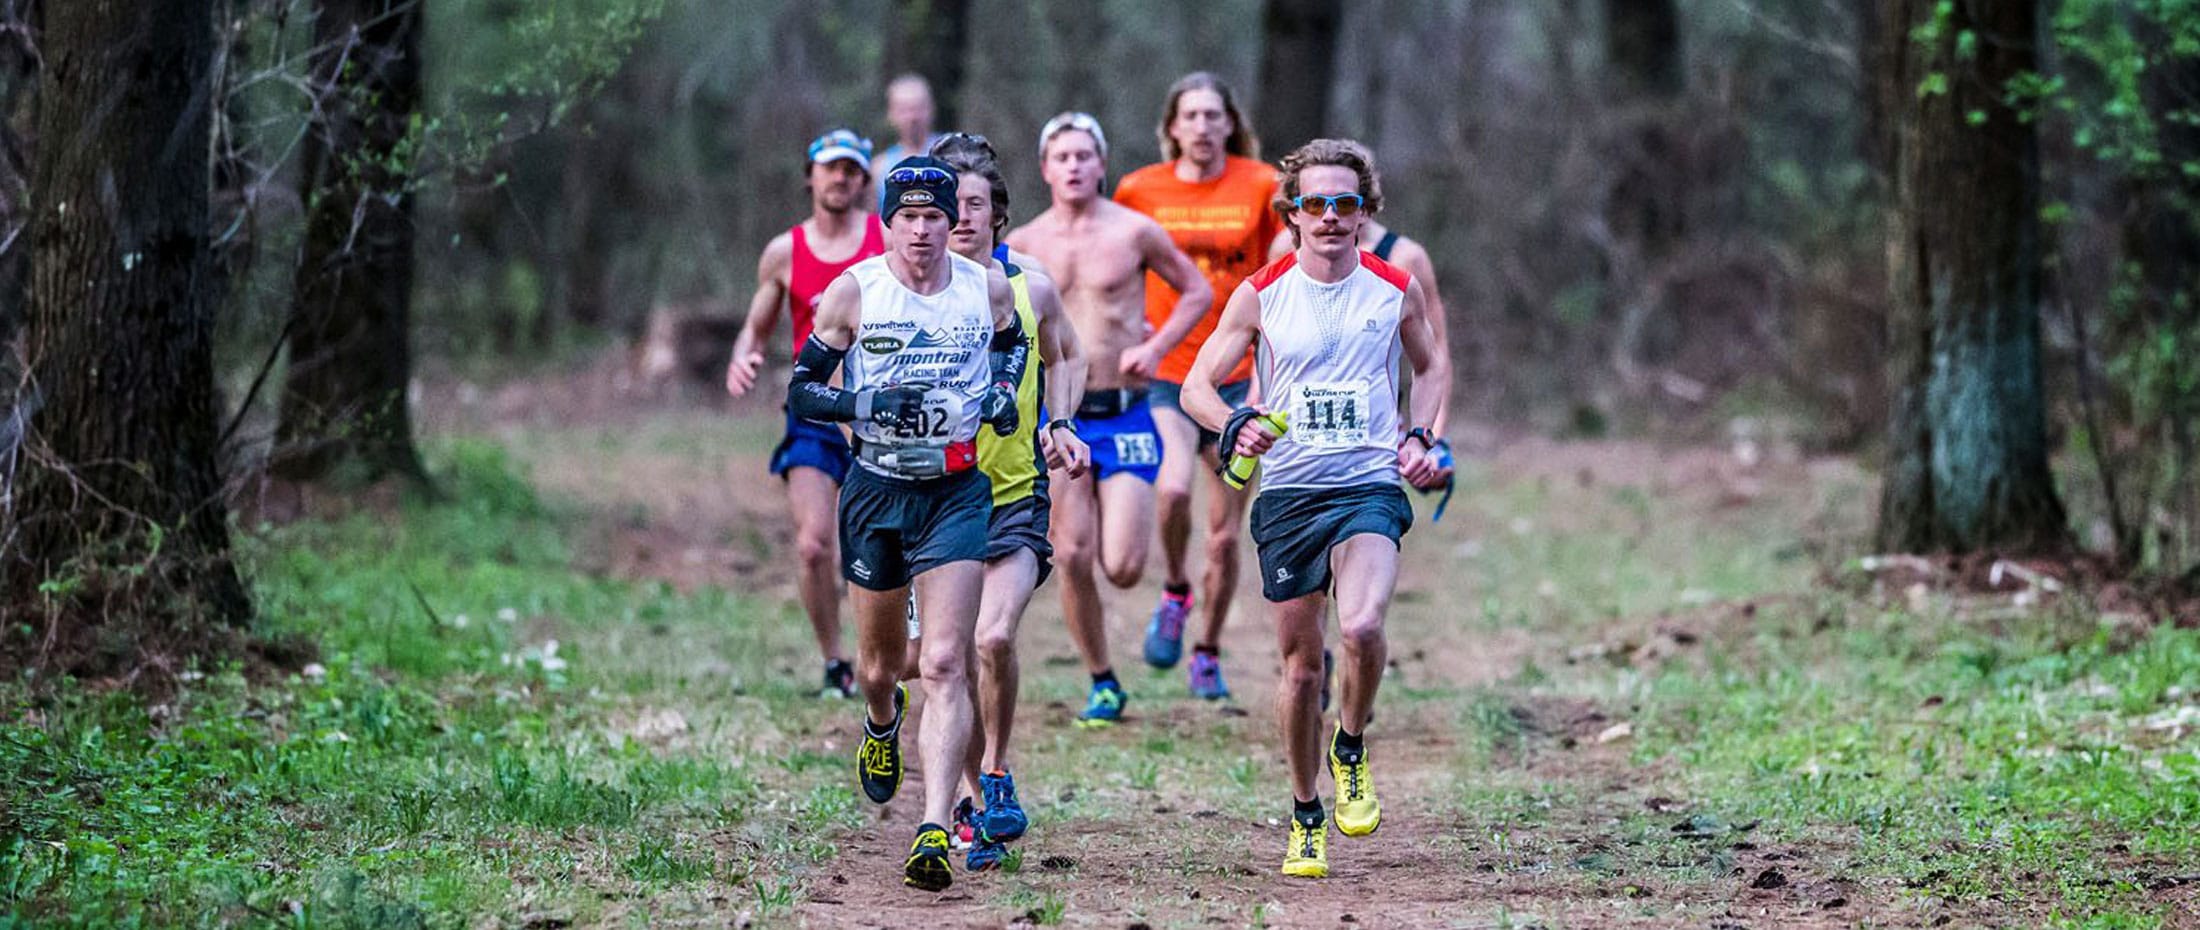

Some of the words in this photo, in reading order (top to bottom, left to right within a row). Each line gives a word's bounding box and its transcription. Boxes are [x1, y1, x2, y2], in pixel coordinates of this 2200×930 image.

[875, 321, 917, 330] swiftwick
[864, 341, 900, 349] FLORA
[893, 351, 971, 365] montrail
[903, 369, 937, 378] RACING
[939, 368, 960, 378] TEAM
[1306, 399, 1356, 430] 114
